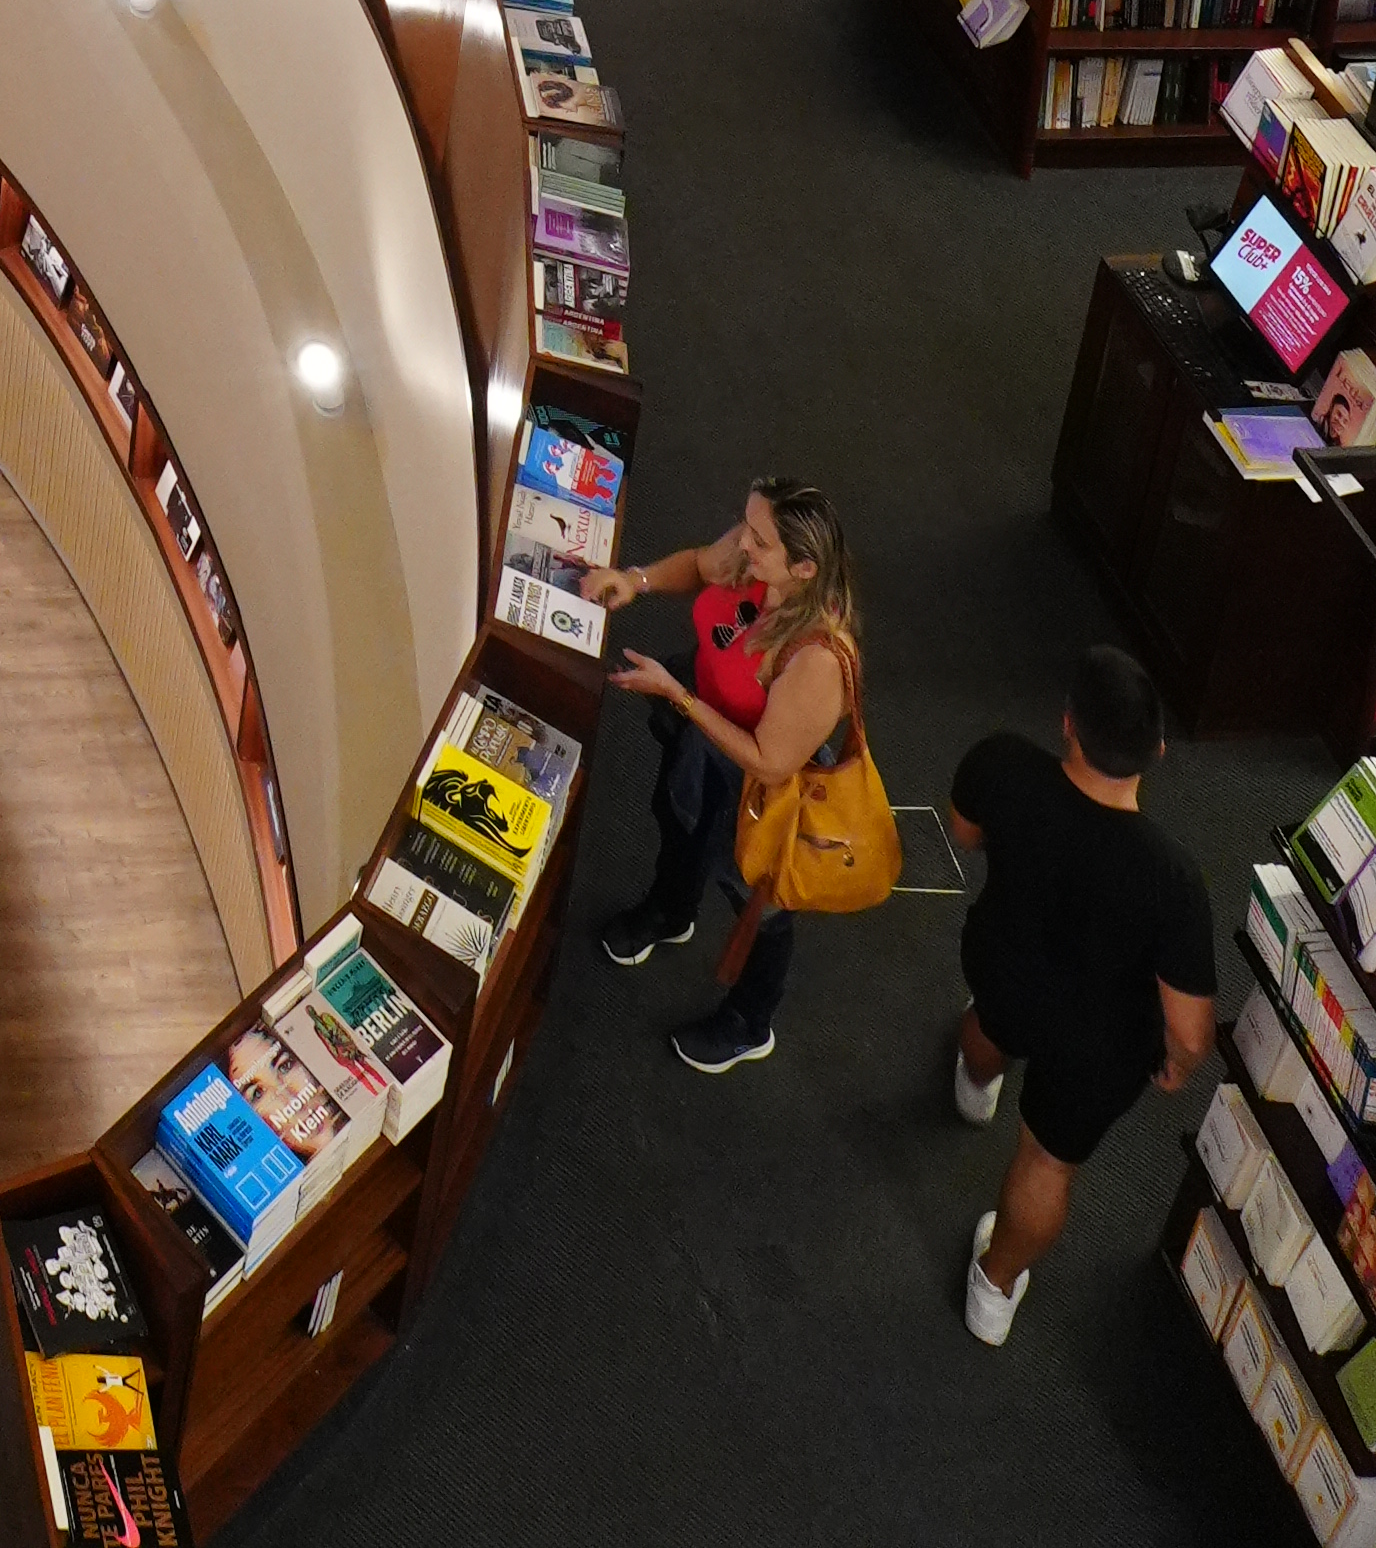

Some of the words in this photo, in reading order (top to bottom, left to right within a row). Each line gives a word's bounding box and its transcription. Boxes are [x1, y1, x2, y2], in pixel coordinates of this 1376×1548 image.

[1240, 228, 1282, 264] SUPER
[1291, 265, 1313, 295] 15%
[567, 507, 592, 557] Nexus
[355, 995, 413, 1047] BERLÍN
[173, 1075, 232, 1136] Antología
[269, 1079, 318, 1130] Naomi
[290, 1104, 330, 1143] Klein
[194, 1122, 225, 1155] KARL
[208, 1139, 244, 1172] MARX
[50, 1393, 66, 1428] PLAN
[69, 1460, 101, 1542] NUNCA
